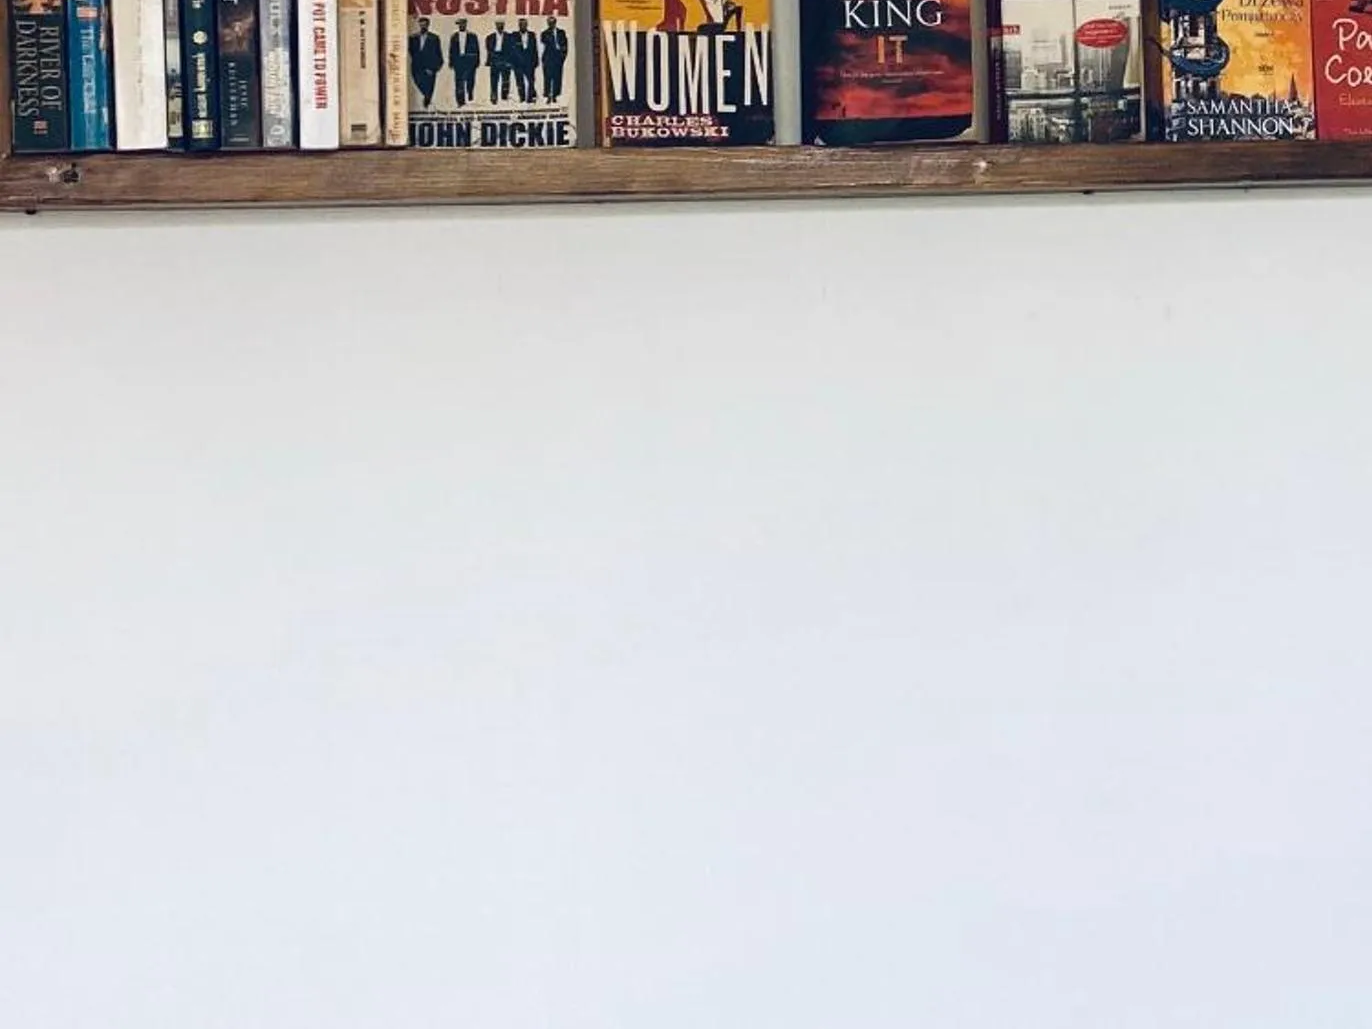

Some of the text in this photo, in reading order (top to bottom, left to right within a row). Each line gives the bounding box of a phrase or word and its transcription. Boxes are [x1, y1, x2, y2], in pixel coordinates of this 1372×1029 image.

[312, 3, 327, 22] POT
[312, 27, 328, 54] CAME
[876, 35, 908, 64] IT
[15, 20, 39, 116] DARKNESS
[39, 26, 63, 110] RIVER OF
[314, 58, 327, 71] TO
[603, 19, 769, 115] WOMEN
[314, 73, 328, 109] POWER
[1186, 98, 1295, 115] SAMANTHA
[611, 115, 713, 126] CHARLES
[611, 126, 729, 137] BUKOWSKI
[1188, 118, 1293, 136] SHANNON
[408, 121, 570, 147] JOHN DICKIE
